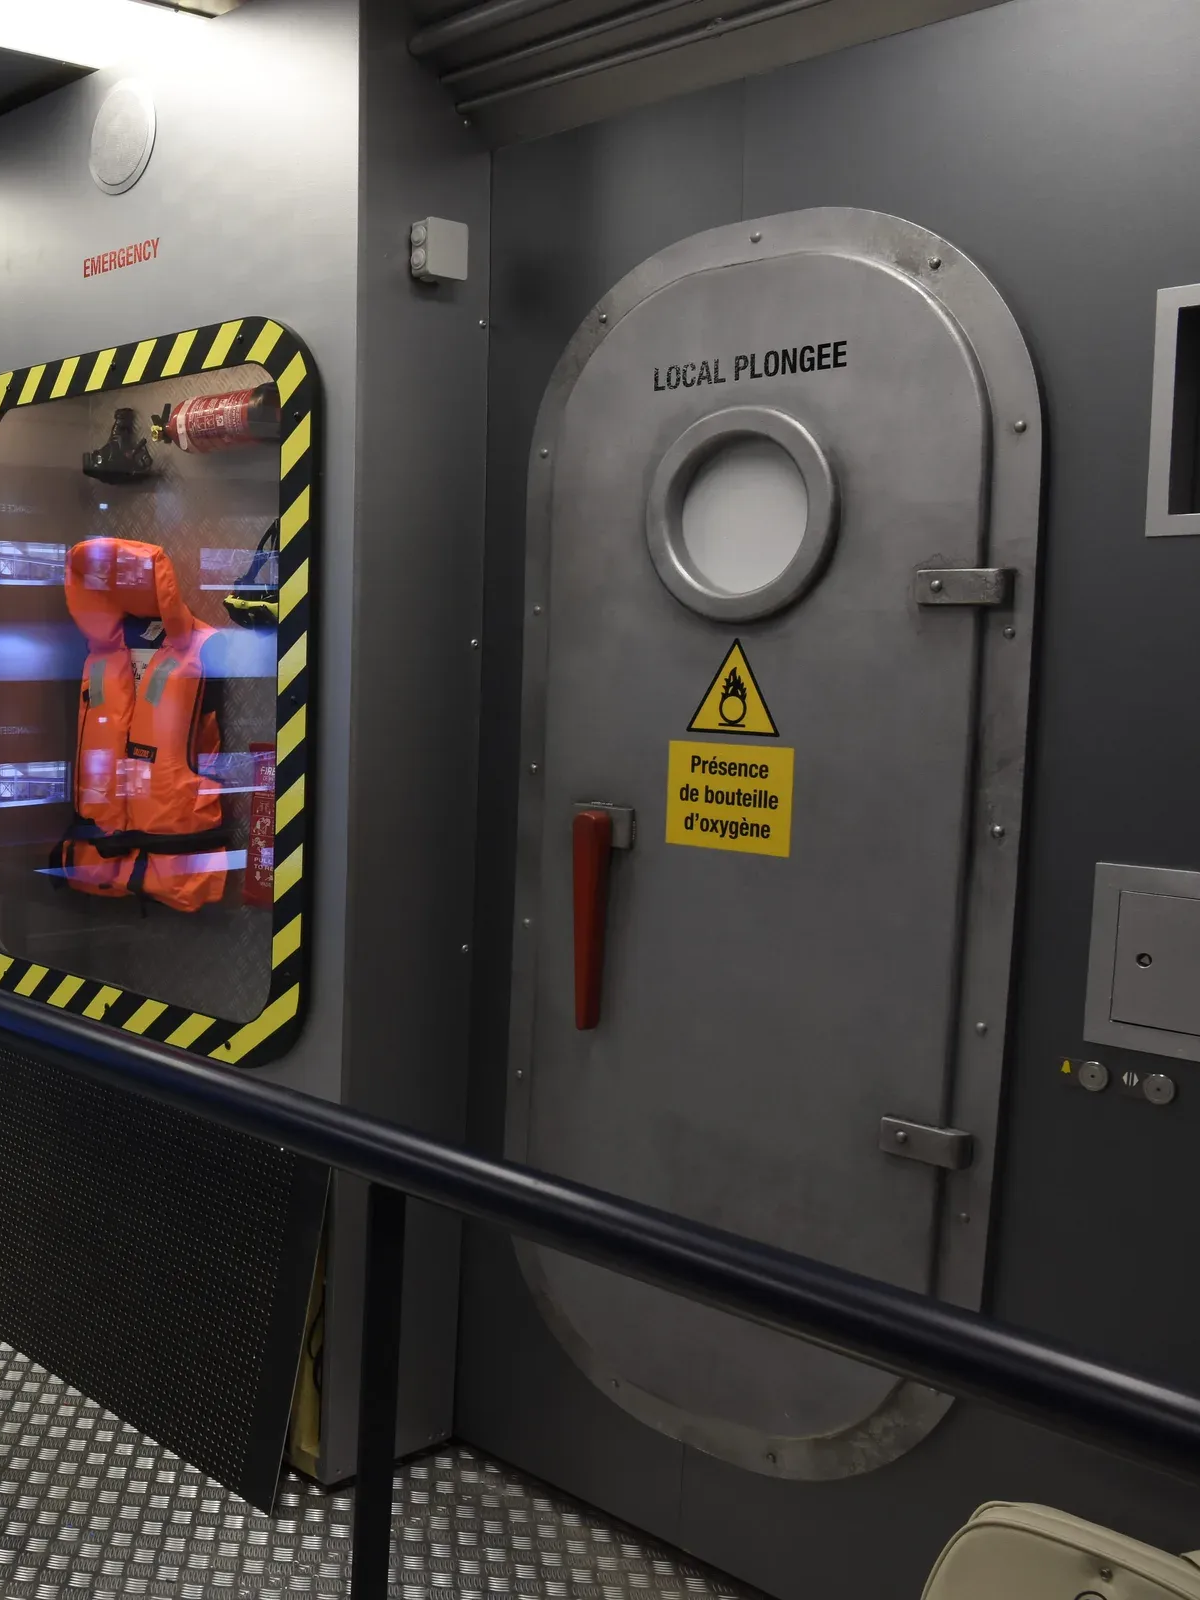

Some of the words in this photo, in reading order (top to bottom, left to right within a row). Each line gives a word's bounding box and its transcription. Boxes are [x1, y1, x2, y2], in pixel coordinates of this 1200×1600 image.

[83, 237, 160, 279] EMERGENCY
[653, 358, 726, 391] LOCAL
[734, 340, 848, 381] PLONGEE
[690, 755, 769, 779] Présence
[679, 783, 699, 803] de
[704, 785, 779, 810] bouteille
[684, 812, 771, 840] d'oxygène
[253, 856, 273, 865] PULL
